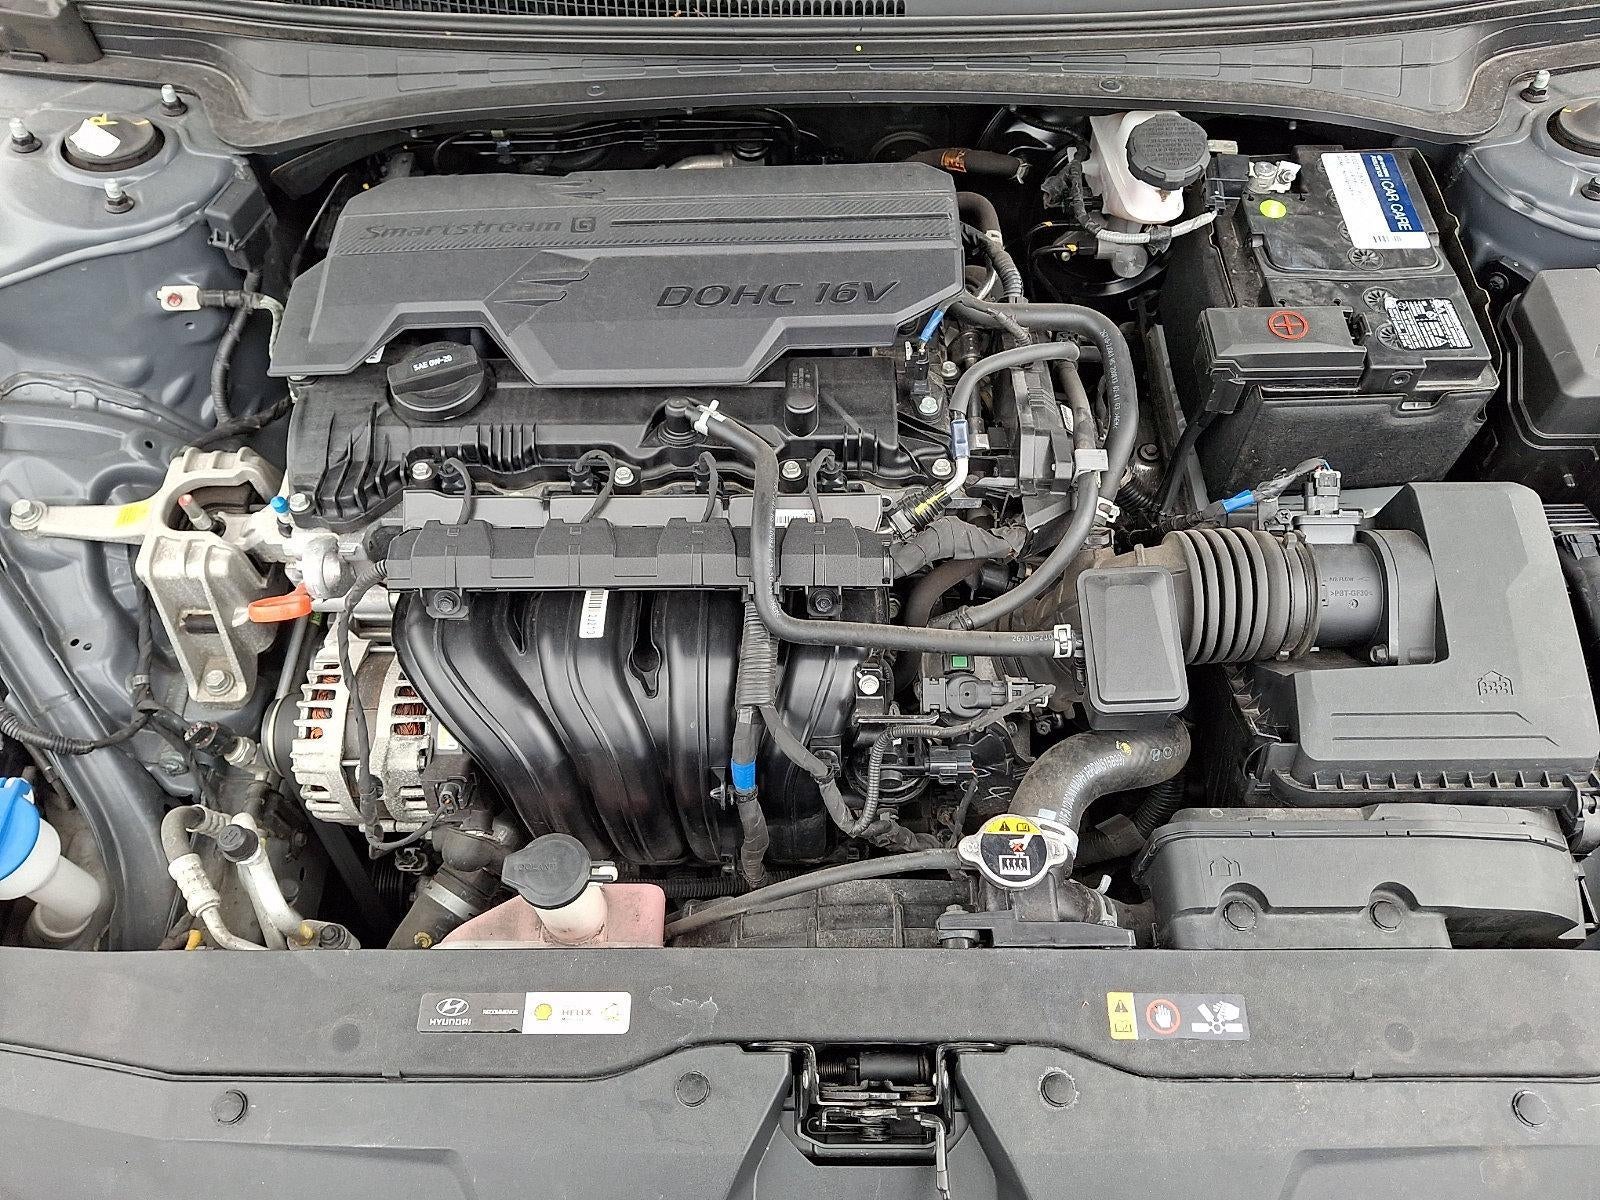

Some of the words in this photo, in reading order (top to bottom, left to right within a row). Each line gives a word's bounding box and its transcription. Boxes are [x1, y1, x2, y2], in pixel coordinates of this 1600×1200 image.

[1381, 180, 1400, 203] CAR
[1390, 203, 1413, 232] CARE
[360, 219, 563, 241] Smartstream
[656, 282, 804, 308] DOHC
[814, 280, 900, 305] 16V
[412, 361, 429, 372] SAE
[428, 354, 453, 367] 0W-20
[428, 1017, 473, 1026] HYUNDAI
